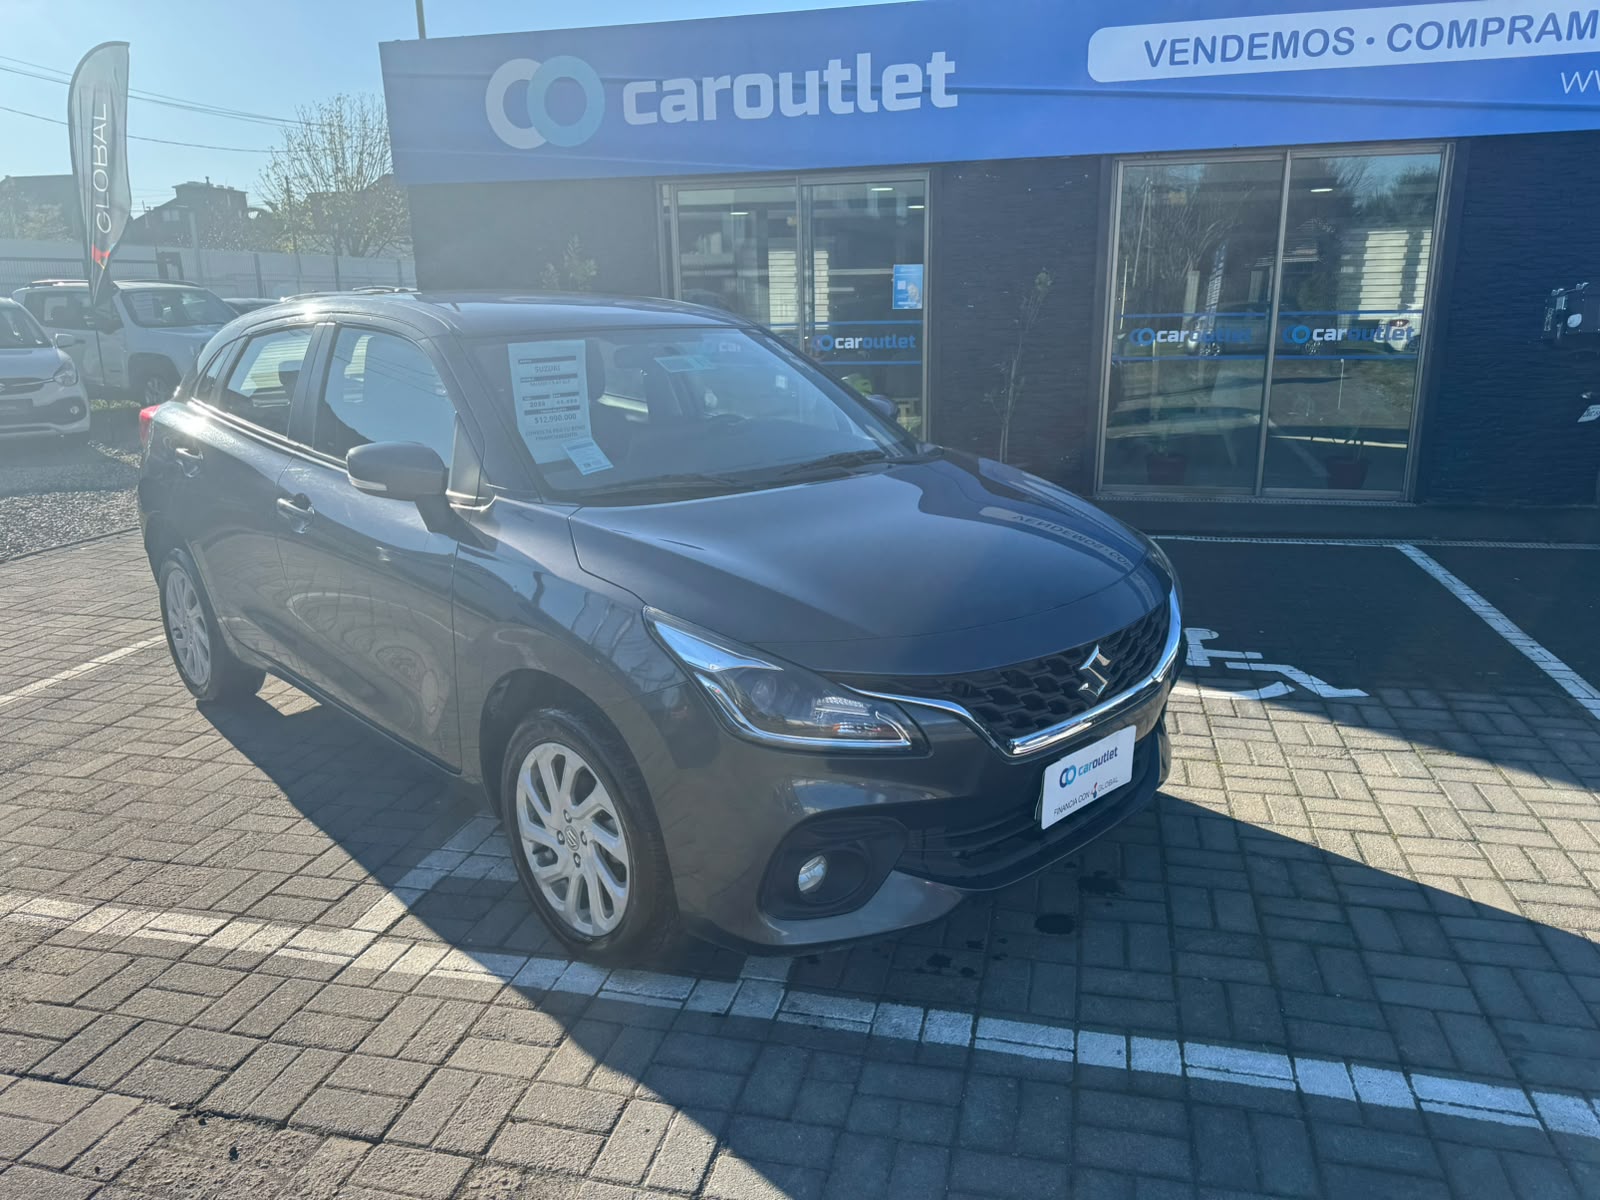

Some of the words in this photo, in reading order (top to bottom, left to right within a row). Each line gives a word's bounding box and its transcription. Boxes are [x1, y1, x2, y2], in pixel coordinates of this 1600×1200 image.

[1144, 26, 1356, 68] VENDEMOS
[1386, 9, 1599, 53] COMPRAM
[622, 51, 958, 126] caroutlet
[92, 103, 112, 234] GLOBAL
[834, 333, 917, 350] caroutlet
[1312, 325, 1415, 342] caroutlet
[1078, 746, 1118, 776] caroutlet
[1053, 798, 1077, 816] FINANCIA
[1078, 791, 1090, 803] CON
[1098, 777, 1118, 792] GLOBAL
